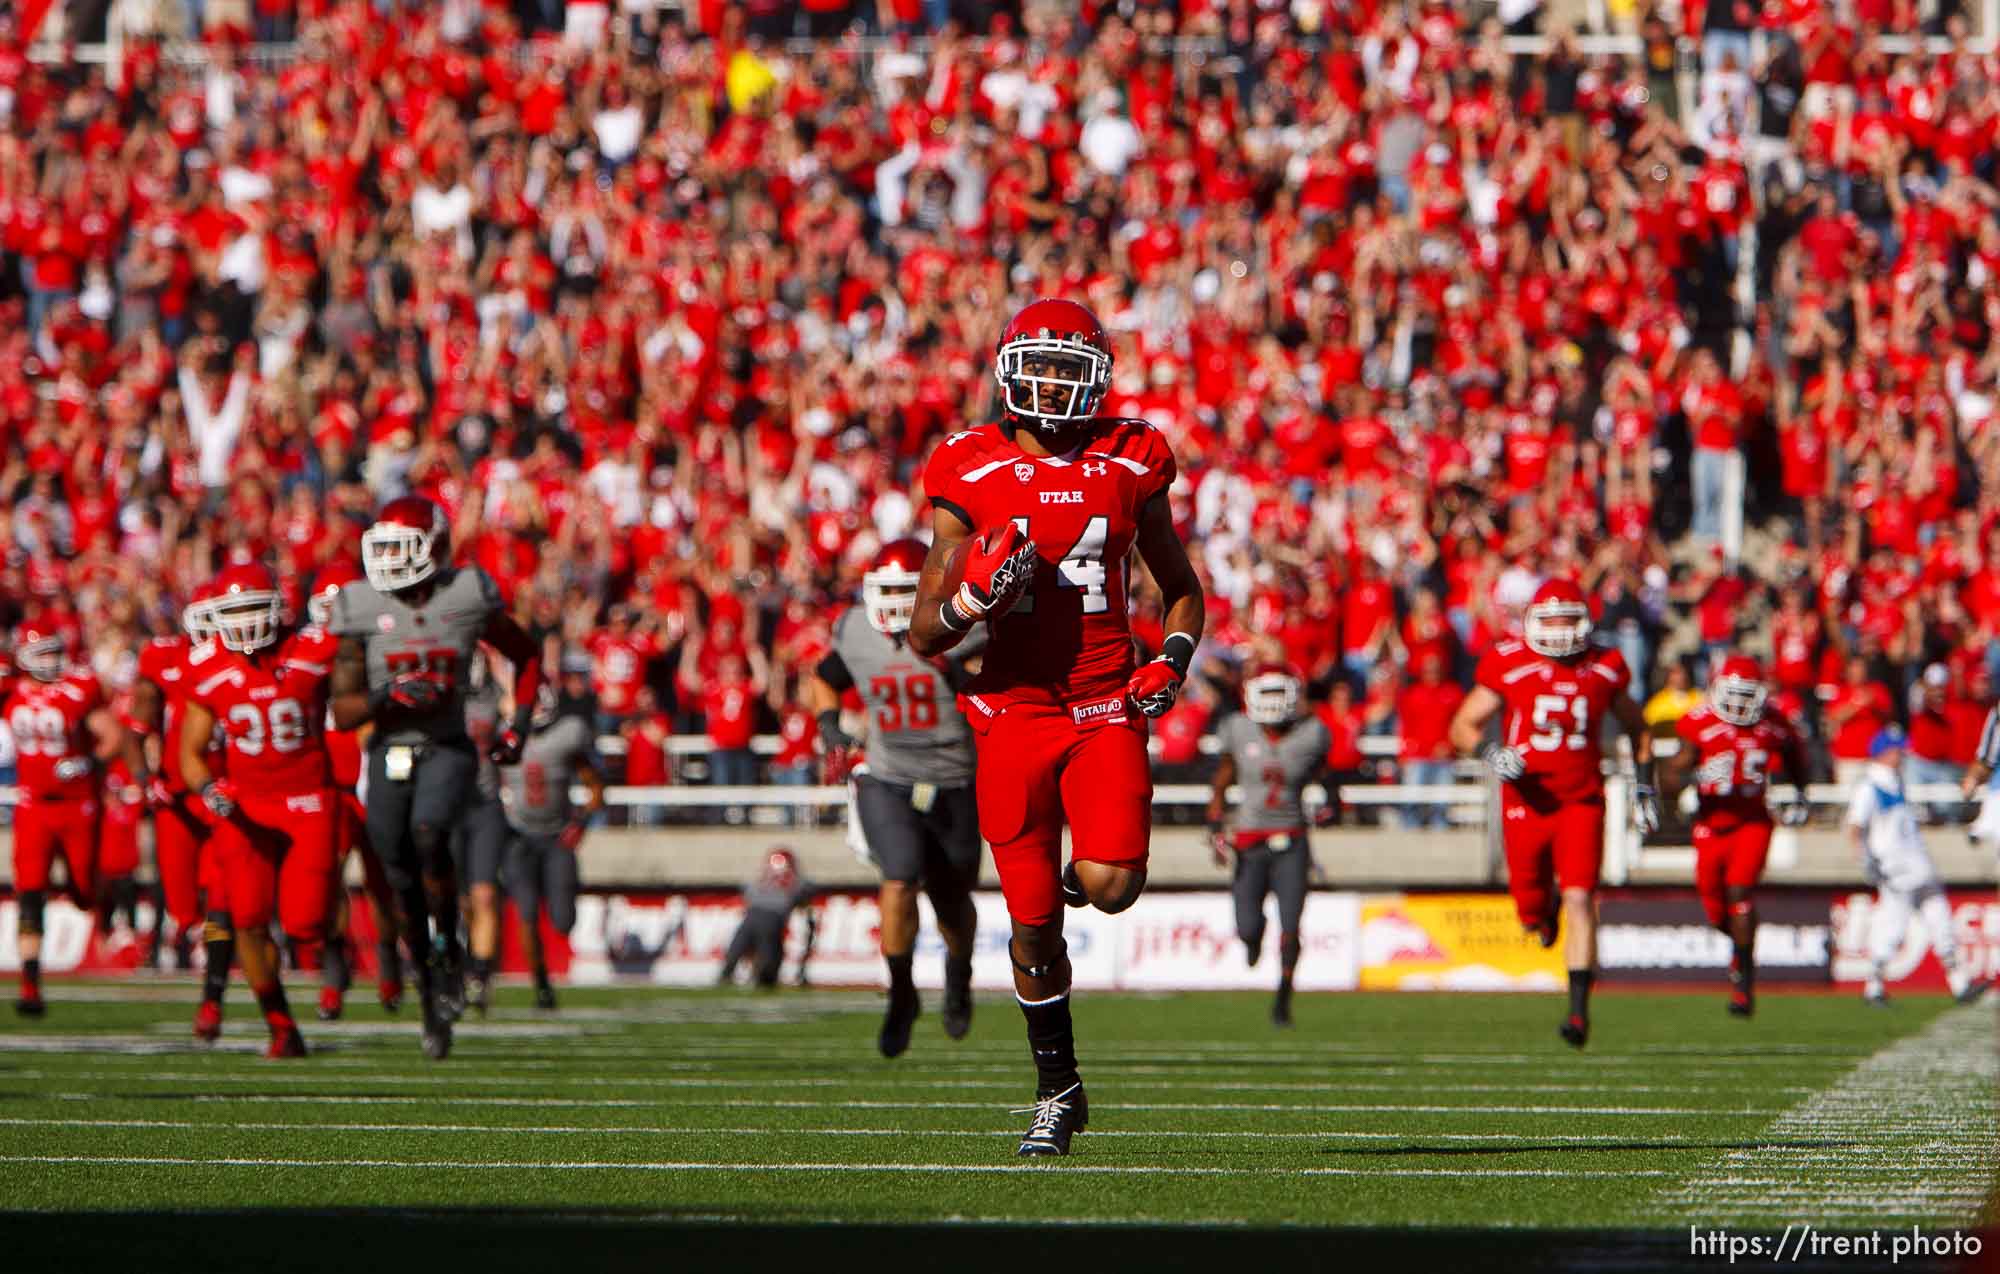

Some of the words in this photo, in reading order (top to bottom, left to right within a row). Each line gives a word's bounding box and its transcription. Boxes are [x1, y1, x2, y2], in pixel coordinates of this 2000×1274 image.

[1039, 491, 1084, 503] UTAH
[228, 697, 305, 757] 38
[869, 673, 939, 733] 38
[1078, 703, 1107, 718] UTAH
[1530, 694, 1589, 751] 51
